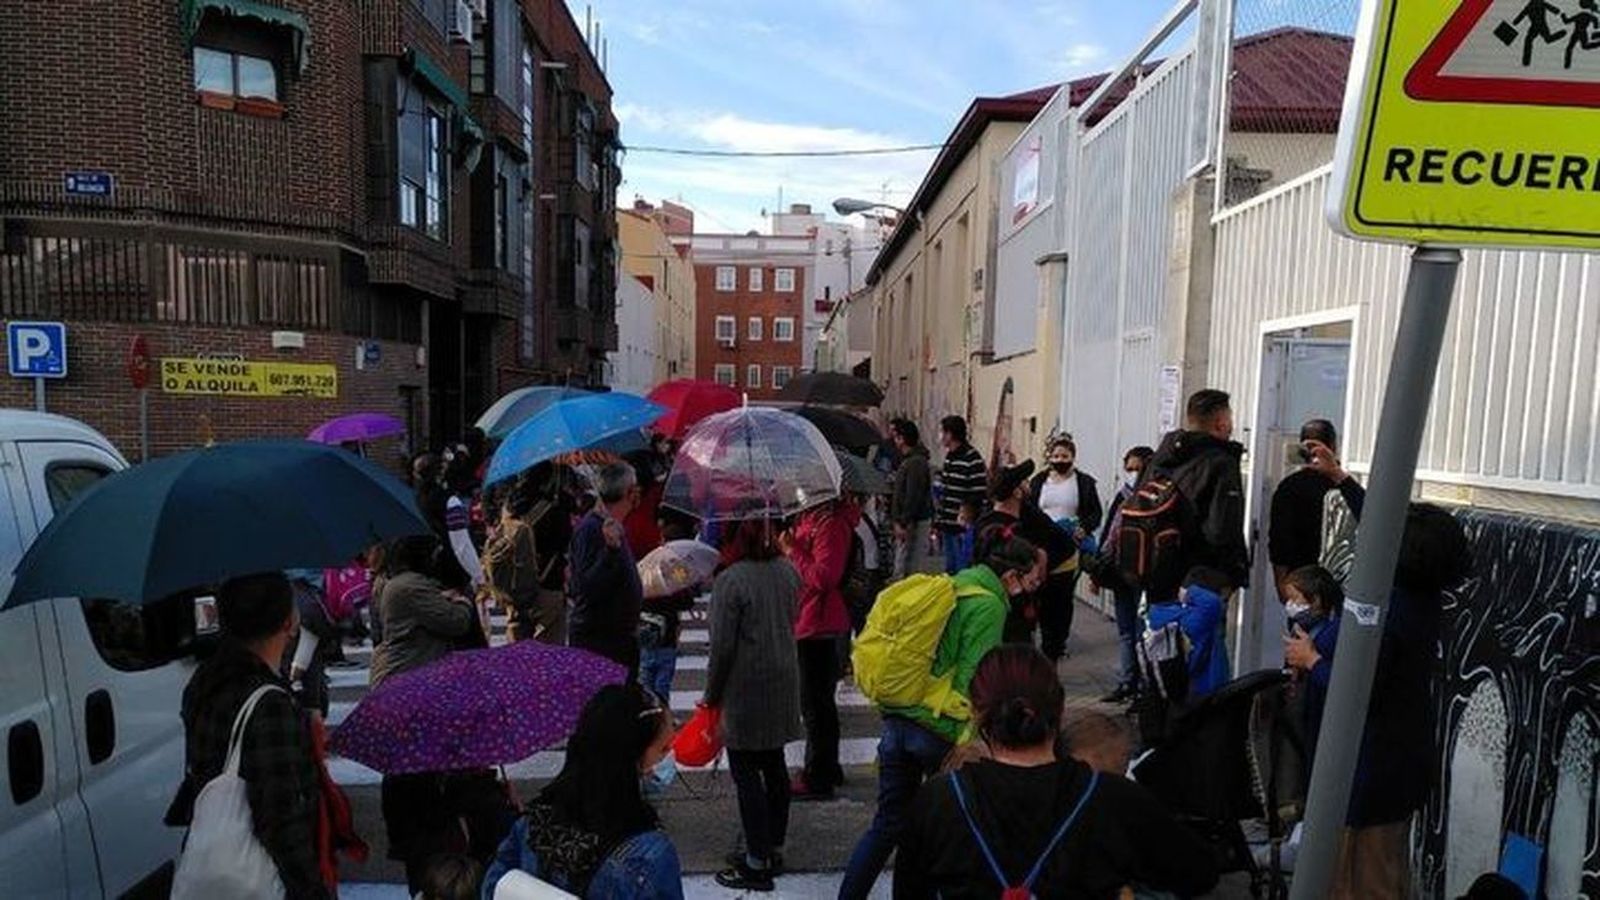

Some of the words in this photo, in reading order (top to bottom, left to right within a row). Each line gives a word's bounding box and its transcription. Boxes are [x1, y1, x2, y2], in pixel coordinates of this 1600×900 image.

[1383, 147, 1600, 192] RECUER
[17, 328, 51, 370] P
[165, 361, 188, 374] SE
[194, 363, 251, 376] VENDE
[165, 377, 179, 390] O
[184, 379, 259, 392] ALQUILA
